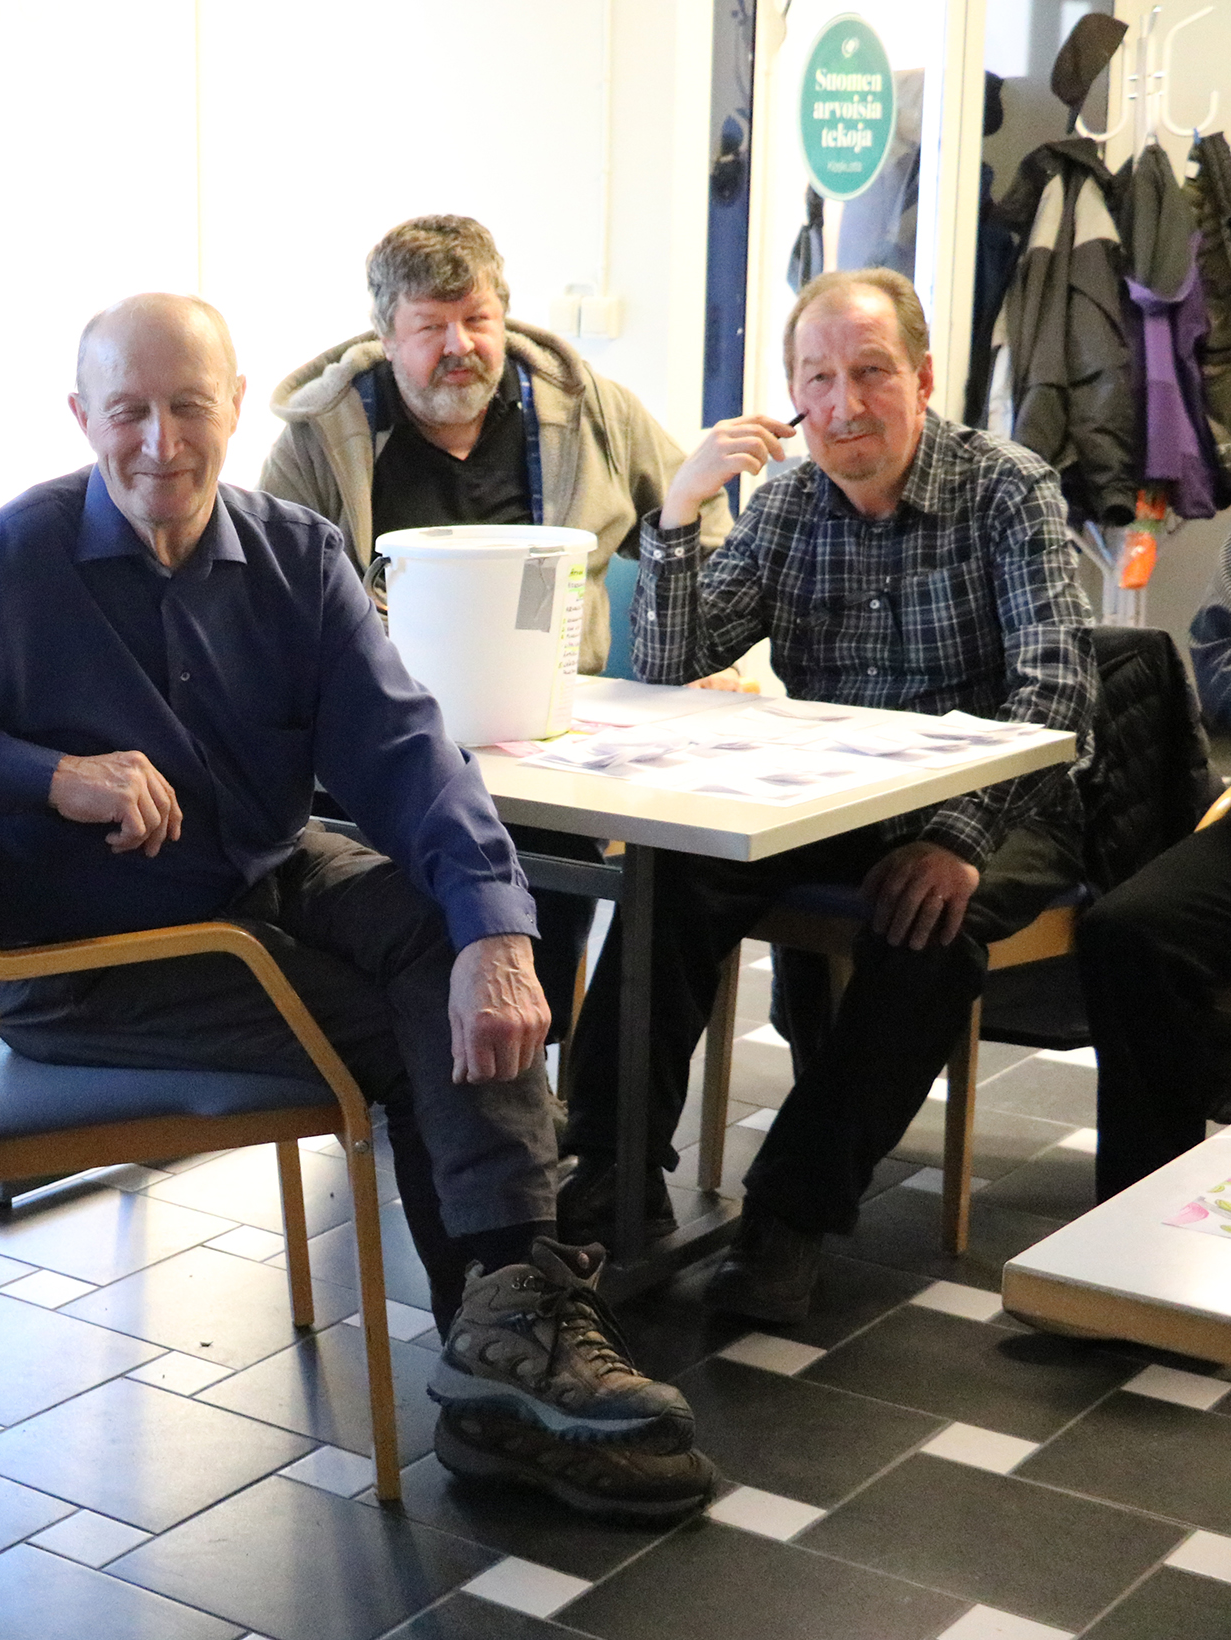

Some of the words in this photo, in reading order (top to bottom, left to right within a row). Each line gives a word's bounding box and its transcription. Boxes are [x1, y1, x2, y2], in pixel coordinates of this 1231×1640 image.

[815, 68, 882, 92] Suomen
[813, 94, 882, 120] arvoisia
[821, 122, 872, 153] tekoja
